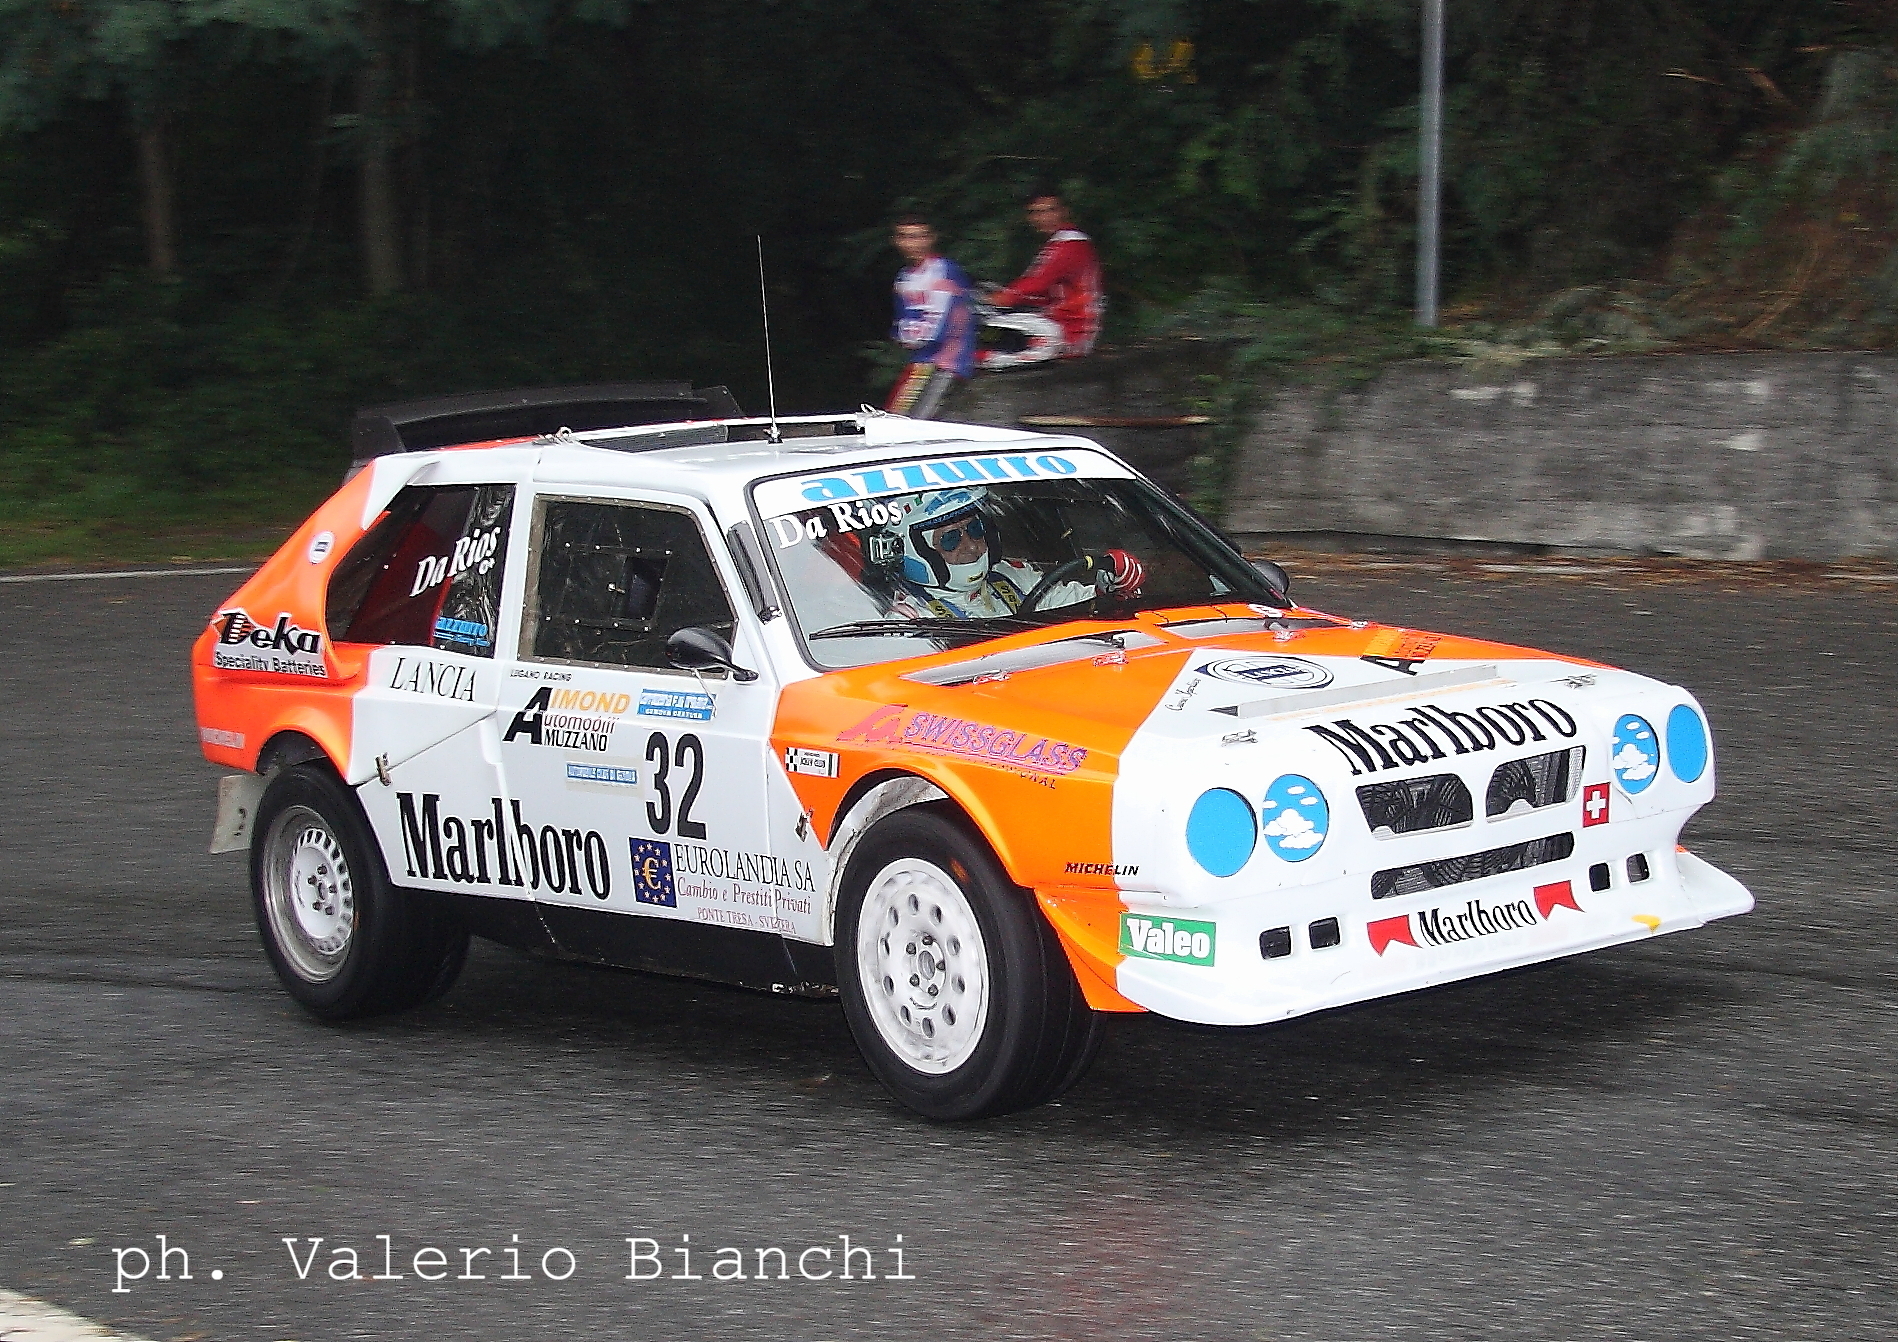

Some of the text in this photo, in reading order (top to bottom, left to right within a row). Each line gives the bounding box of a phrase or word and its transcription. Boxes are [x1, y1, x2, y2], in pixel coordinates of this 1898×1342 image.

[801, 455, 1078, 501] azzurro
[769, 514, 827, 549] Da
[828, 502, 902, 534] Rios
[409, 526, 501, 597] Da Rios
[215, 651, 326, 677] Speciality Batteries
[389, 656, 477, 702] LANCIA
[544, 729, 608, 752] MUZZANO
[903, 711, 1088, 772] SWISSGLASS
[1302, 698, 1578, 776] Marlboro
[645, 731, 707, 840] 32
[396, 792, 611, 900] Marlboro
[674, 843, 816, 892] EUROLANDIA SA
[1064, 862, 1139, 876] MICHELIN
[677, 876, 812, 915] Cambio e Prestiti Privati
[698, 907, 725, 922] PONTE
[1126, 918, 1210, 958] Valeo
[1418, 899, 1538, 947] Marlboro
